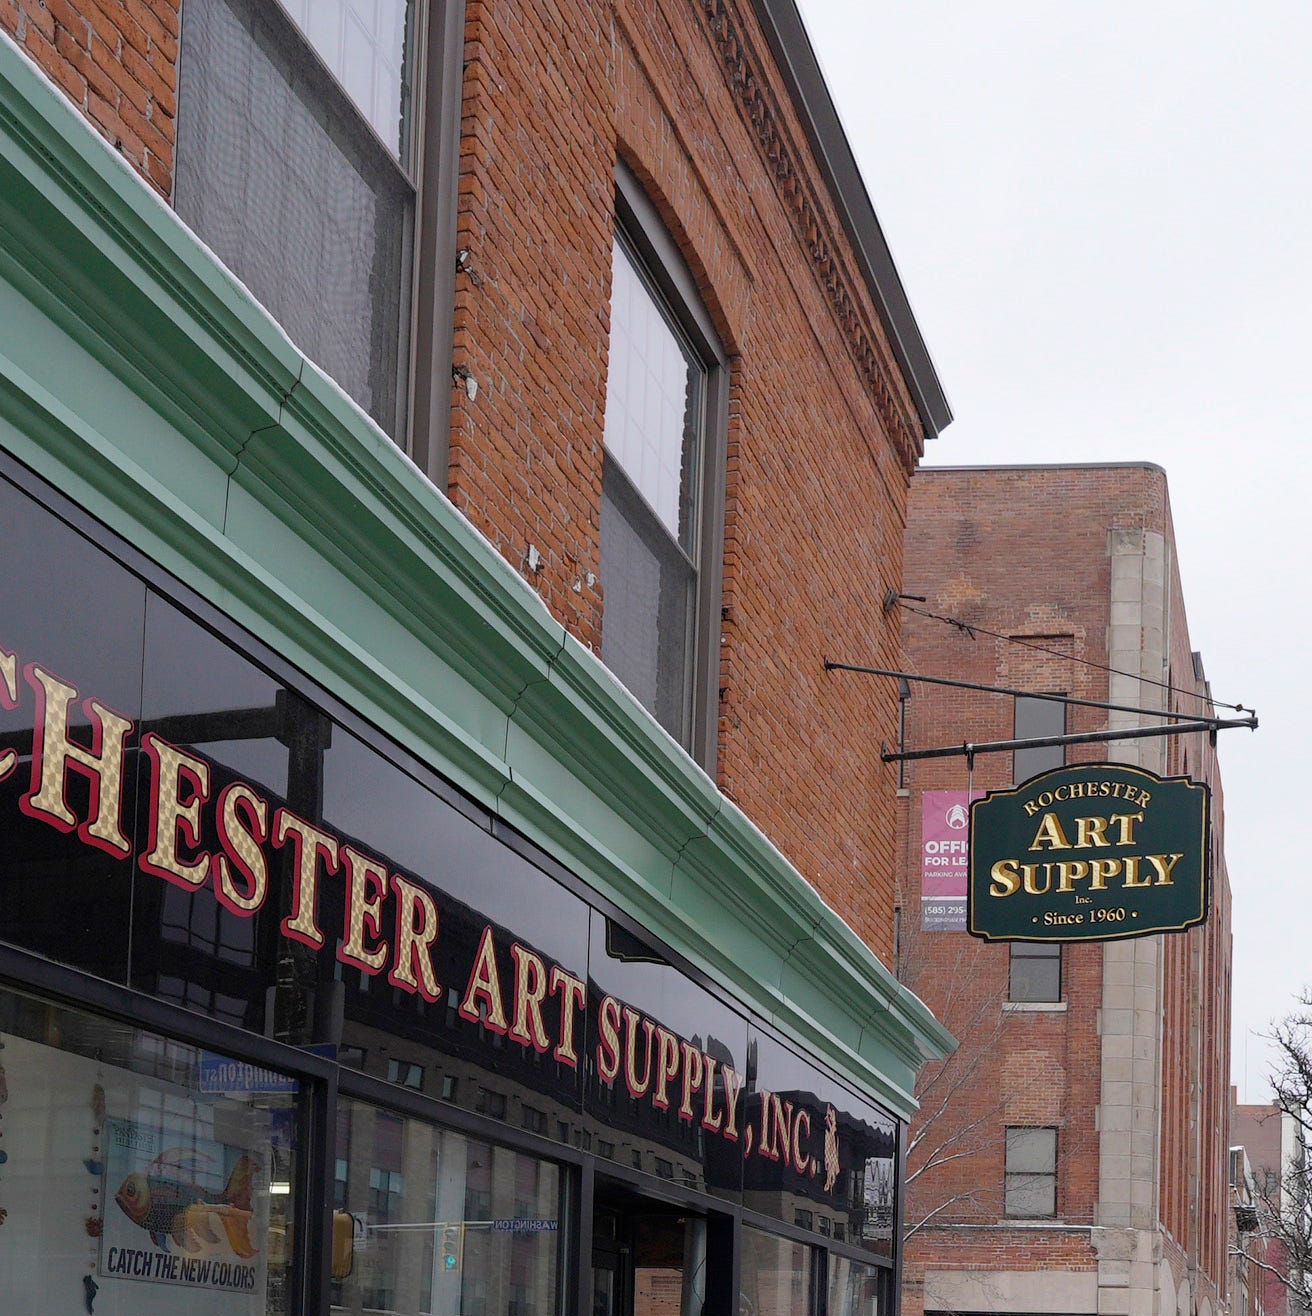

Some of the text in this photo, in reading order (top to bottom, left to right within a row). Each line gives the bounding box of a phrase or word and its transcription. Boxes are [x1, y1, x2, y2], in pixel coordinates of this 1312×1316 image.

[1022, 781, 1152, 817] ROCHESTER
[1028, 811, 1145, 851] ART
[924, 841, 968, 854] OFFI
[924, 857, 968, 866] FOR LE
[989, 853, 1184, 898] SUPPLY
[924, 906, 946, 915] (585)
[1075, 896, 1093, 904] Inc.
[1043, 908, 1126, 926] Since 1960
[460, 926, 586, 1066] ART
[597, 994, 754, 1158] SUPPLY,
[759, 1087, 820, 1178] INC.
[108, 1247, 256, 1289] CATCH THE NEW COLORS
